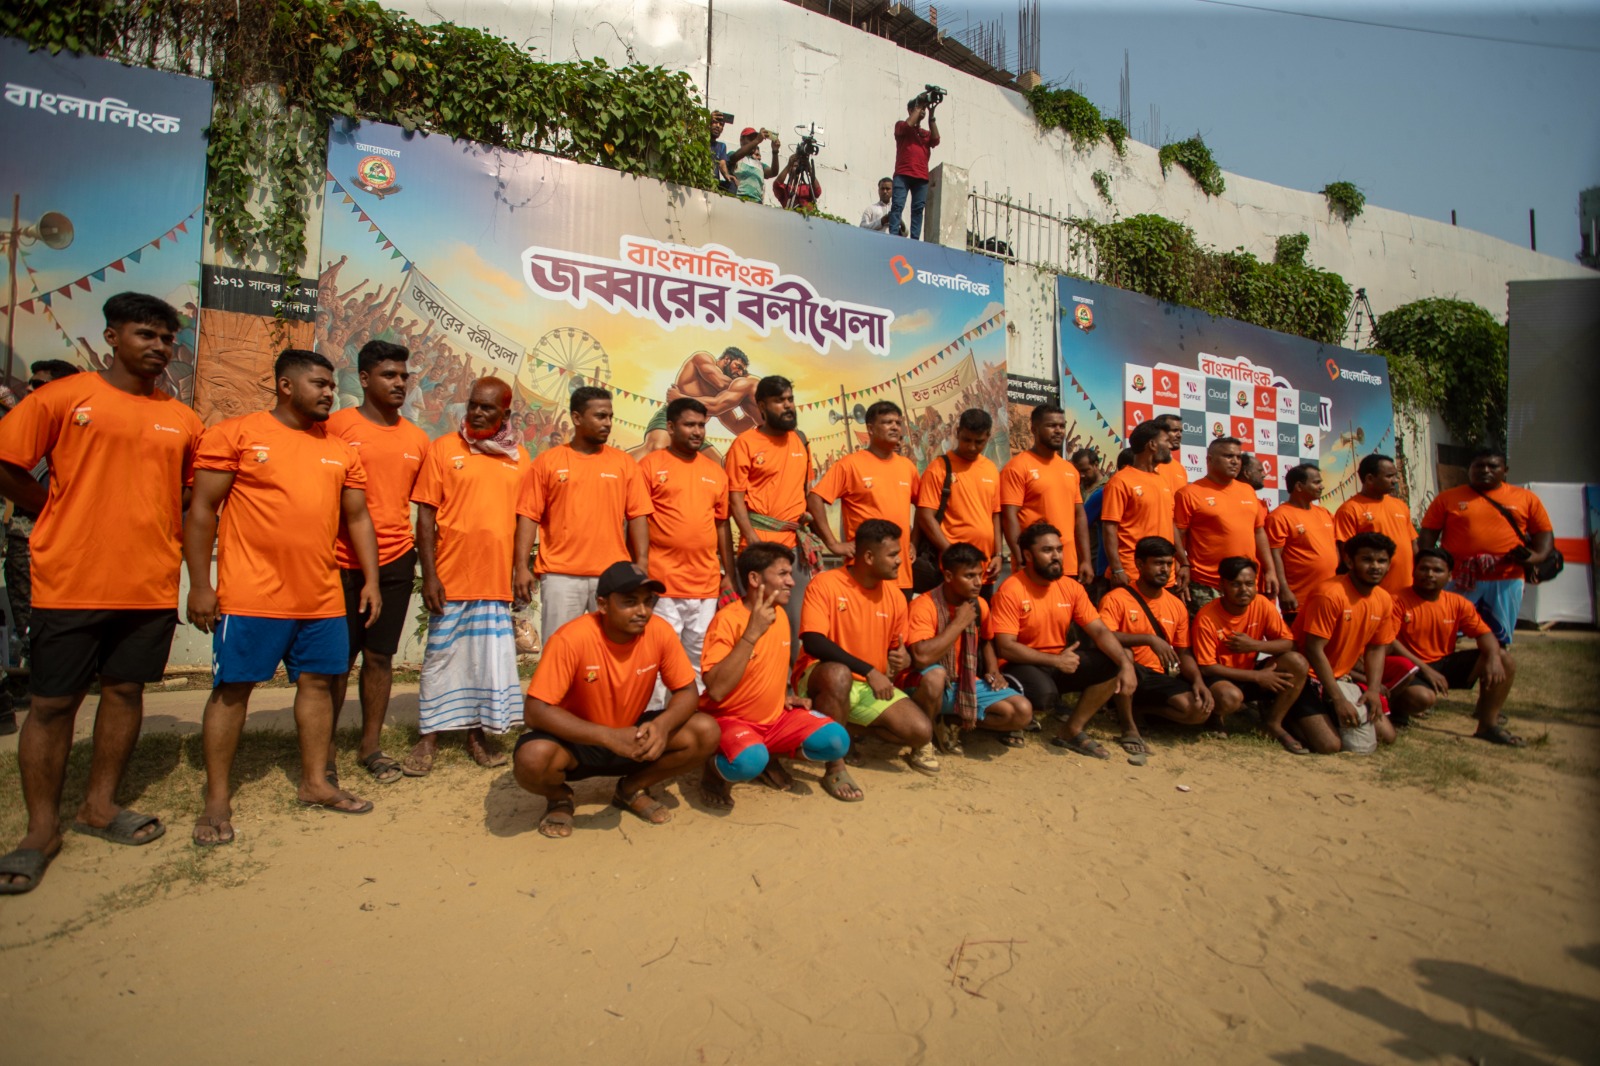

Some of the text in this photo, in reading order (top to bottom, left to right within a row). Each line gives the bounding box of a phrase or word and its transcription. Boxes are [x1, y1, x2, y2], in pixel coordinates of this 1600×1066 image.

[4, 82, 181, 134] বাংলালিংক
[356, 142, 401, 158] আয়োজনে
[627, 242, 774, 287] বাংলালিংক
[213, 275, 244, 288] ১৯৭১
[248, 280, 281, 293] সালের
[917, 269, 990, 297] বাংলালিংক
[530, 254, 888, 349] জব্বারের বলীখেলা
[467, 325, 518, 366] বলীখেলা
[1202, 358, 1271, 386] বাংলালিংক
[1340, 368, 1382, 386] বাংলালিংক
[911, 370, 960, 402] শুভ নববর্ষ
[1207, 388, 1228, 400] Cloud
[1183, 393, 1201, 401] TOFFEE
[1280, 408, 1297, 416] TOFFEE
[1300, 402, 1318, 413] Cloud
[1182, 422, 1203, 434] Cloud
[1258, 439, 1275, 447] TOFFEE
[1278, 433, 1297, 444] Cloud
